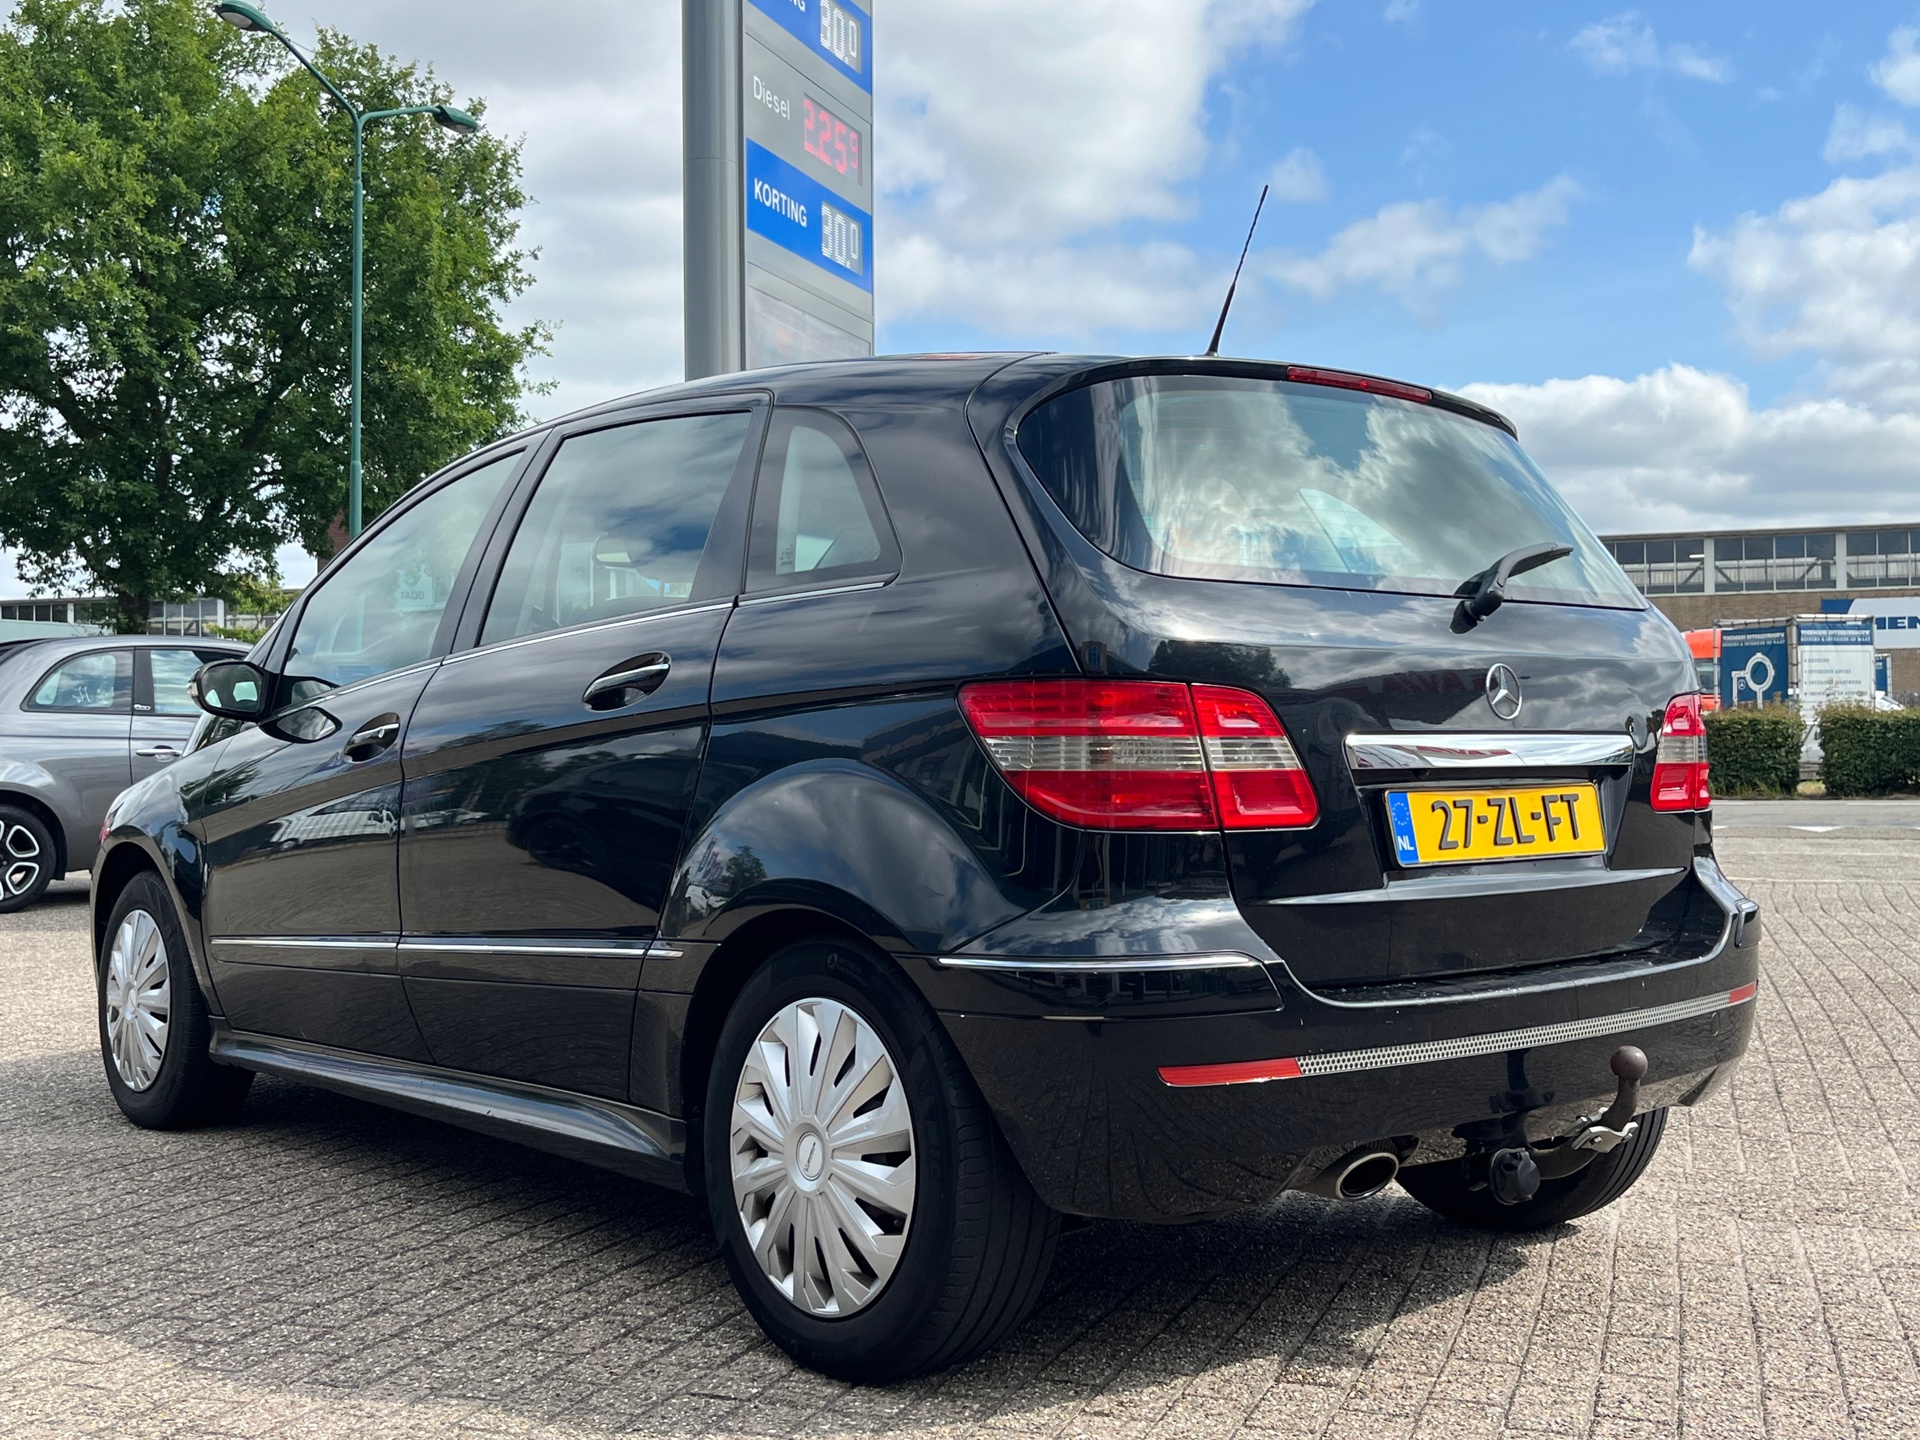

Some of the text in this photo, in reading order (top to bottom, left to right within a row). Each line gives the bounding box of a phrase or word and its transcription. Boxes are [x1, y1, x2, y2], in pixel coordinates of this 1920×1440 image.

[753, 75, 790, 120] Diesel
[754, 177, 807, 228] KORTING
[1397, 835, 1415, 851] NL
[1431, 793, 1580, 850] 27-ZL-FT
